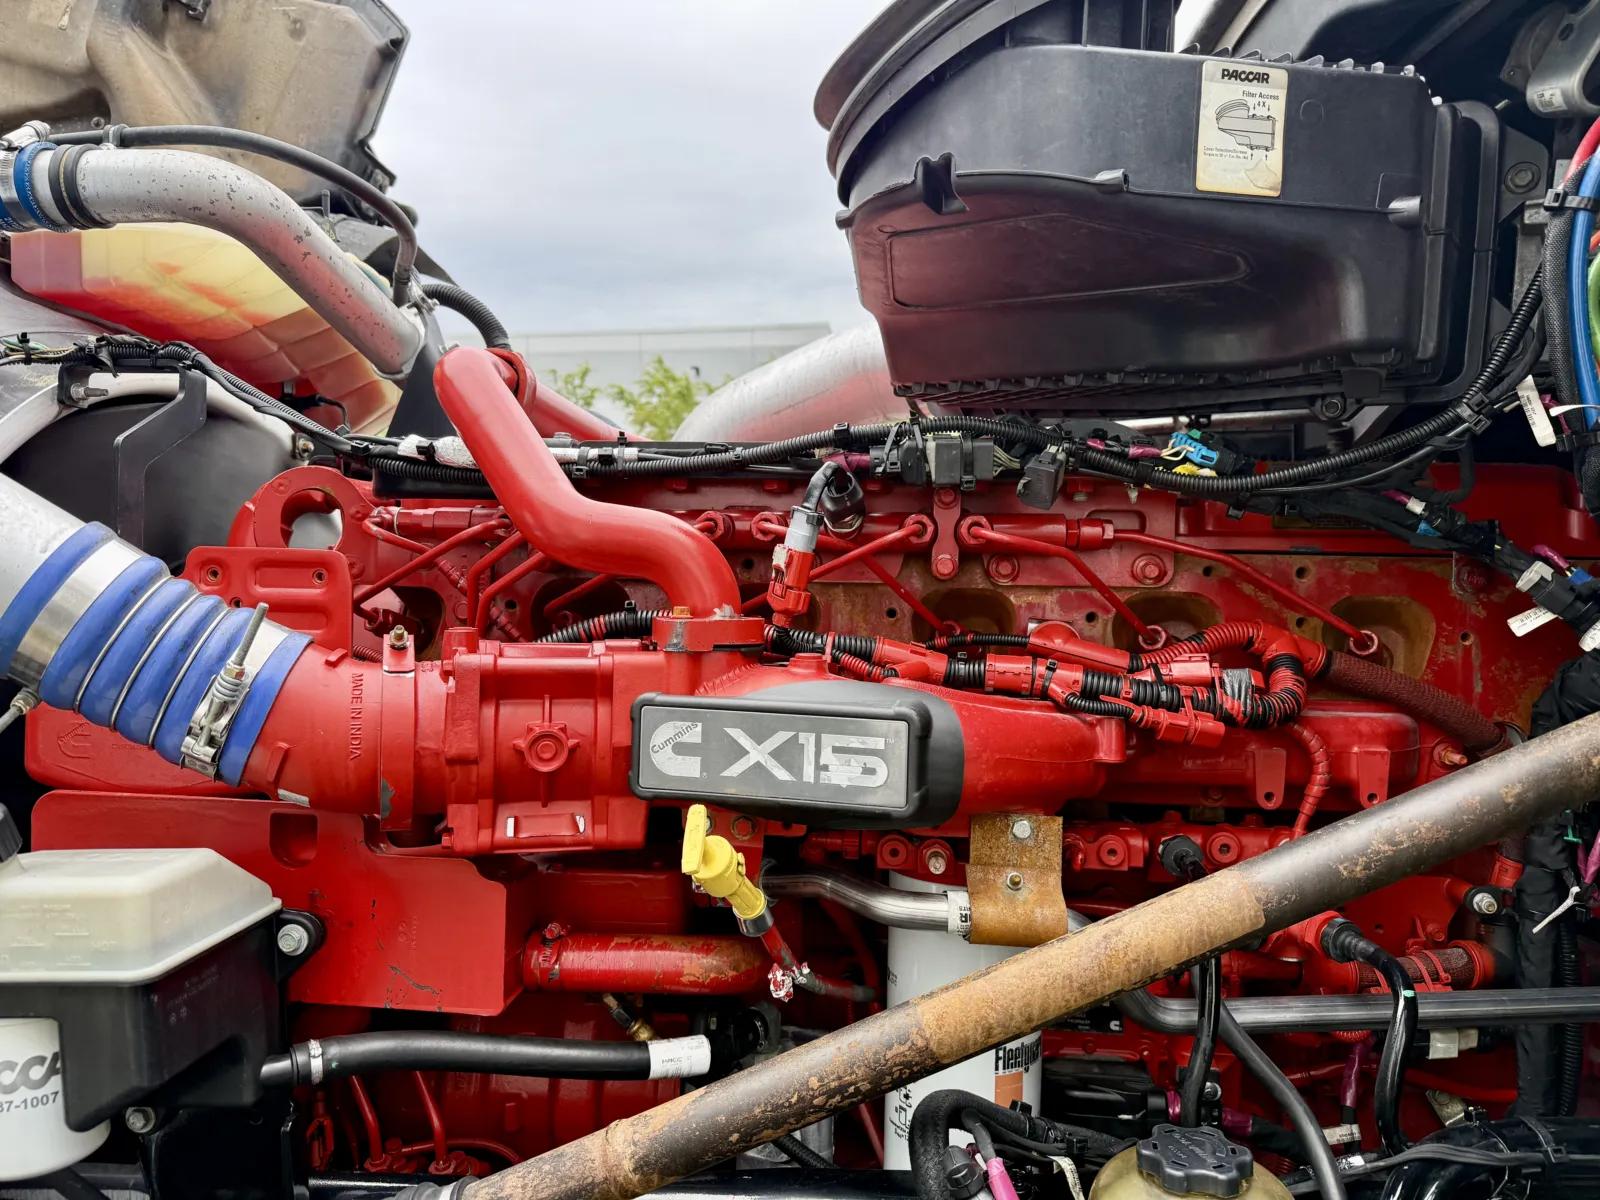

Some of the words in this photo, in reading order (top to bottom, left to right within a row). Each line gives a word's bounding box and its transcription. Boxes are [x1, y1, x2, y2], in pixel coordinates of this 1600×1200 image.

[1221, 68, 1270, 84] PACCAR
[1242, 90, 1257, 99] Filter
[1258, 92, 1279, 101] Access
[350, 673, 364, 704] MADE
[350, 707, 363, 720] IN
[350, 723, 363, 761] INDIA
[650, 721, 699, 755] Cummins
[719, 727, 889, 788] X15
